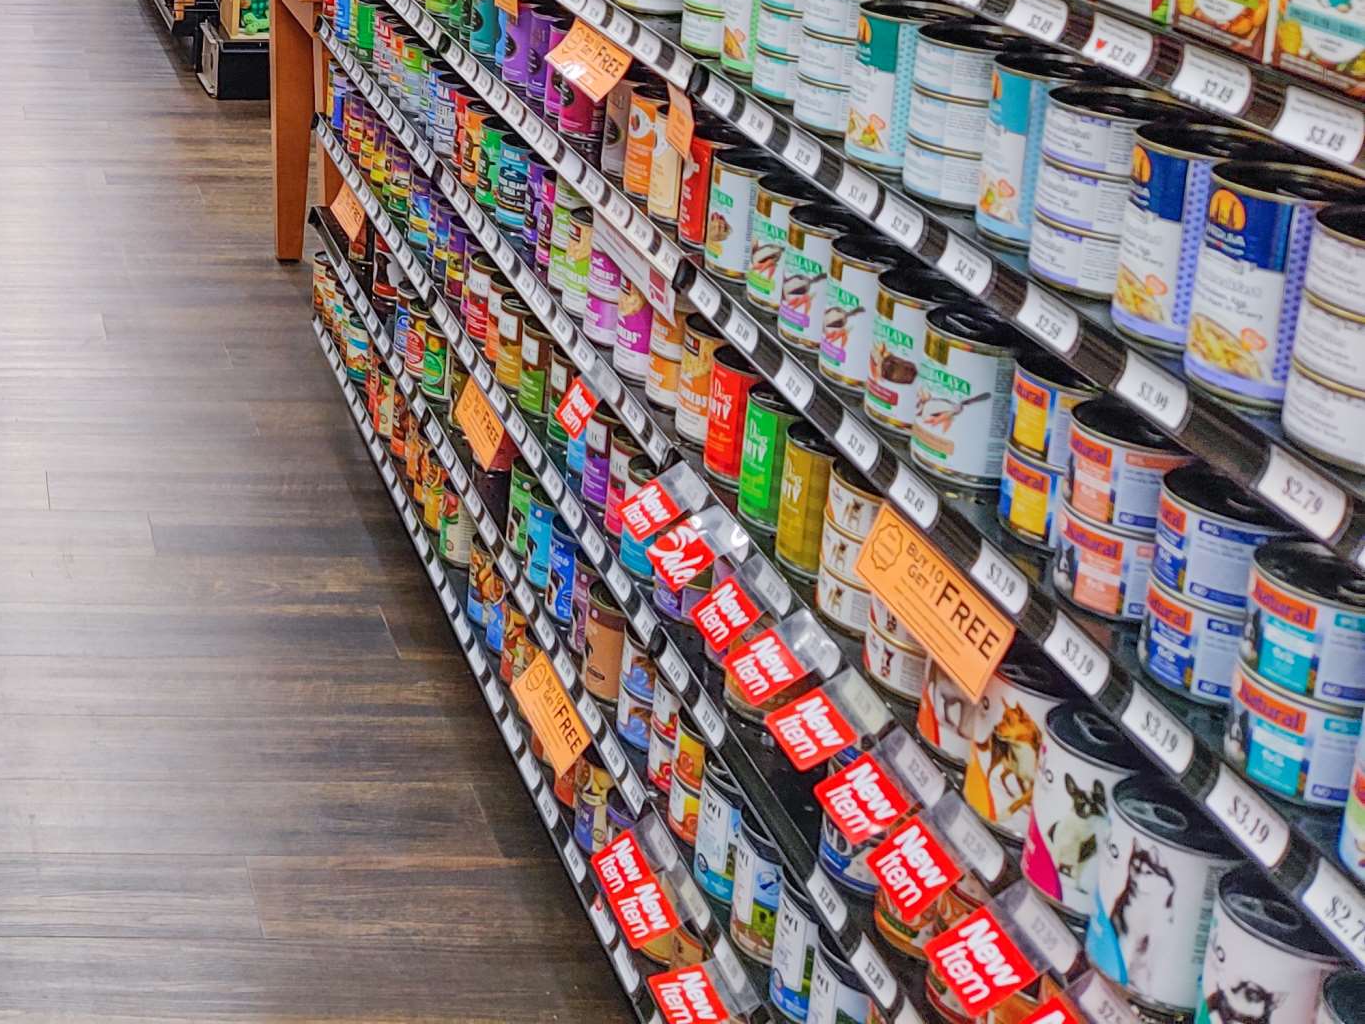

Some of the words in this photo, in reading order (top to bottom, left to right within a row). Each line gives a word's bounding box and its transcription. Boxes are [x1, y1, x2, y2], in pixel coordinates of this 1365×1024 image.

[594, 44, 625, 80] FREE
[559, 401, 583, 434] Item
[568, 386, 592, 419] New
[481, 410, 502, 446] FREE
[637, 483, 671, 524] New
[1281, 476, 1324, 515] $2.79
[621, 502, 653, 536] Item
[1065, 518, 1121, 560] Natural
[648, 523, 705, 588] Sale
[905, 539, 930, 568] BUY
[927, 562, 944, 586] 10
[906, 564, 932, 590] GET
[986, 561, 1016, 597] $3.19
[696, 602, 731, 645] Item
[711, 582, 751, 629] New
[936, 581, 1001, 662] FREE
[1254, 580, 1313, 626] Natural
[731, 654, 771, 697] Item
[749, 634, 795, 684] New
[1061, 637, 1095, 677] $3.19
[795, 695, 846, 748] New
[1241, 682, 1302, 729] Natural
[553, 705, 584, 756] FREE
[775, 715, 820, 760] Item
[1142, 709, 1180, 754] $3.19
[825, 783, 872, 835] Item
[844, 761, 897, 823] New
[1228, 794, 1271, 844] $3.19
[598, 852, 626, 895] Item
[611, 837, 643, 883] New
[875, 848, 923, 909] Item
[892, 824, 948, 888] New
[617, 897, 651, 940] Item
[634, 881, 671, 930] New
[936, 943, 991, 1005] Item
[958, 917, 1022, 988] New
[676, 970, 717, 1021] New
